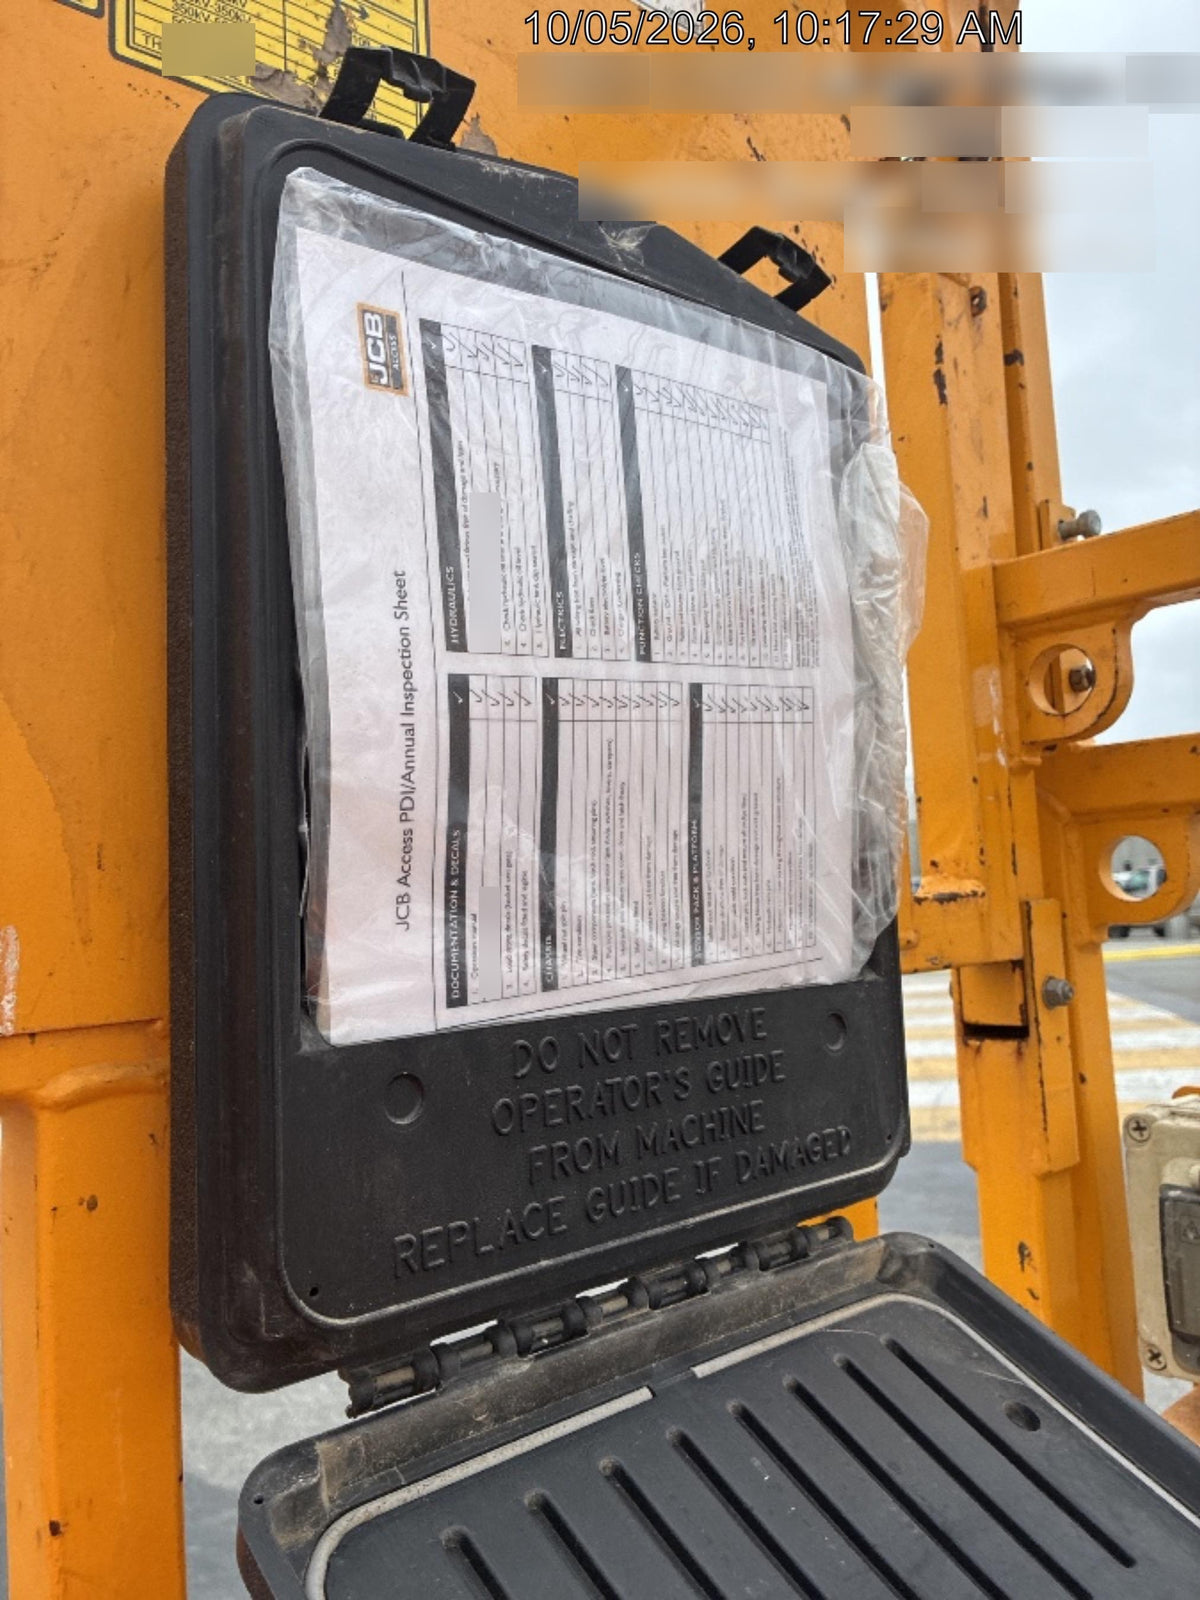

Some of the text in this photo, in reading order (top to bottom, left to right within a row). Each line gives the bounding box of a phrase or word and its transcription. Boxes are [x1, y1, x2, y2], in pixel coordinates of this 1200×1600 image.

[364, 312, 388, 385] JCB
[444, 565, 460, 643] HYDRAULICS
[634, 597, 648, 655] FUNCTION
[393, 569, 417, 931] JCB Access PDI/Annual Inspection Sheet
[449, 829, 460, 999] DOCUMENTATION & DECALS
[513, 1007, 767, 1080] DO NOT REMOVE
[491, 1050, 786, 1136] OPERATOR'S GUIDE
[529, 1100, 766, 1185] FROM MACHINE
[393, 1125, 853, 1279] REPLACE GUIDE IF DAMAGED
